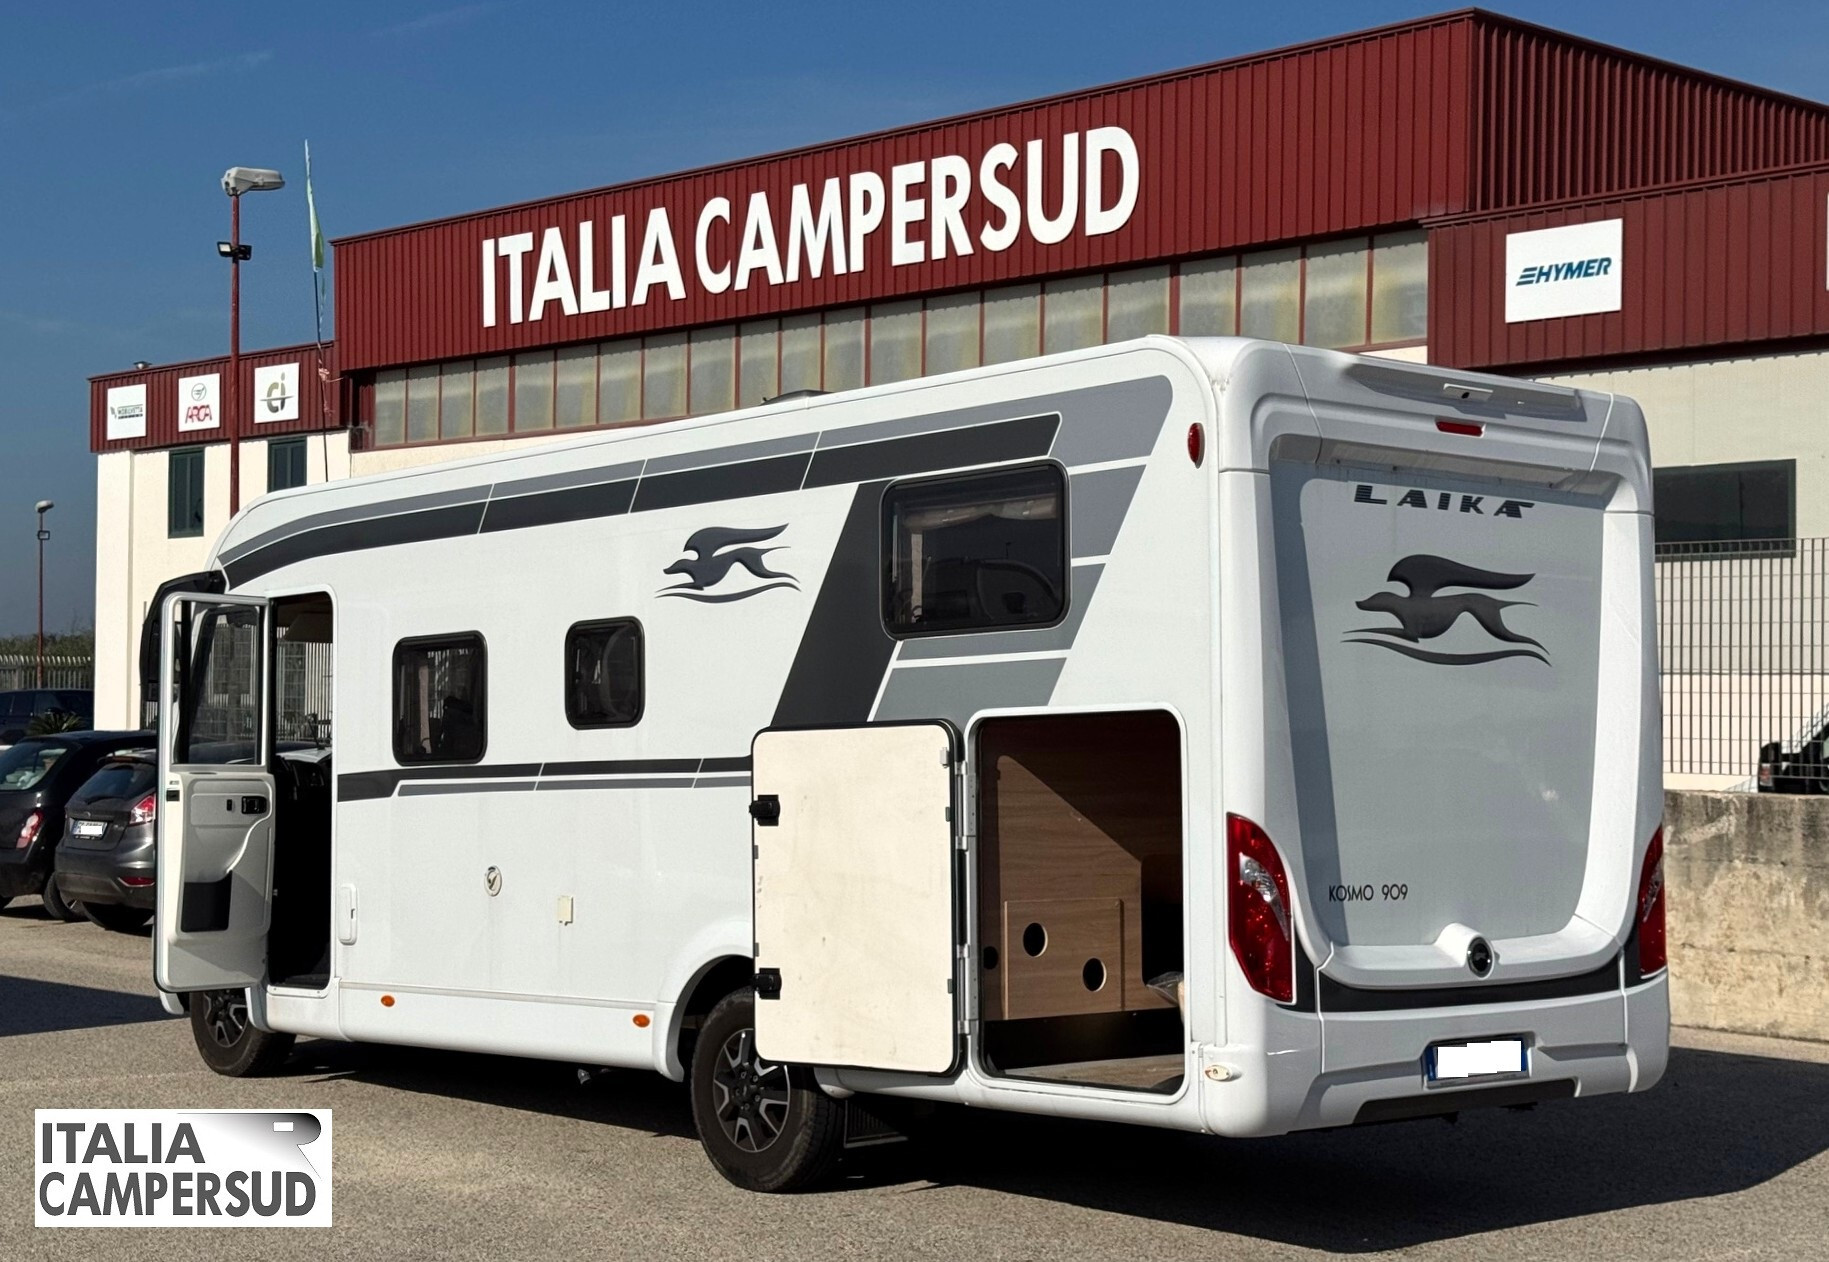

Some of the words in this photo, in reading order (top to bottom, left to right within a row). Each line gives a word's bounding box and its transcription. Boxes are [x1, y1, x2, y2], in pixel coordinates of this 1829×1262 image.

[482, 207, 686, 328] ITALIA
[695, 126, 1139, 294] CAMPERSUD
[1534, 257, 1612, 284] HYMER
[185, 404, 213, 424] ARCA
[1354, 484, 1536, 519] LAIKA
[1328, 884, 1374, 902] KOSMO
[1381, 883, 1409, 901] 909
